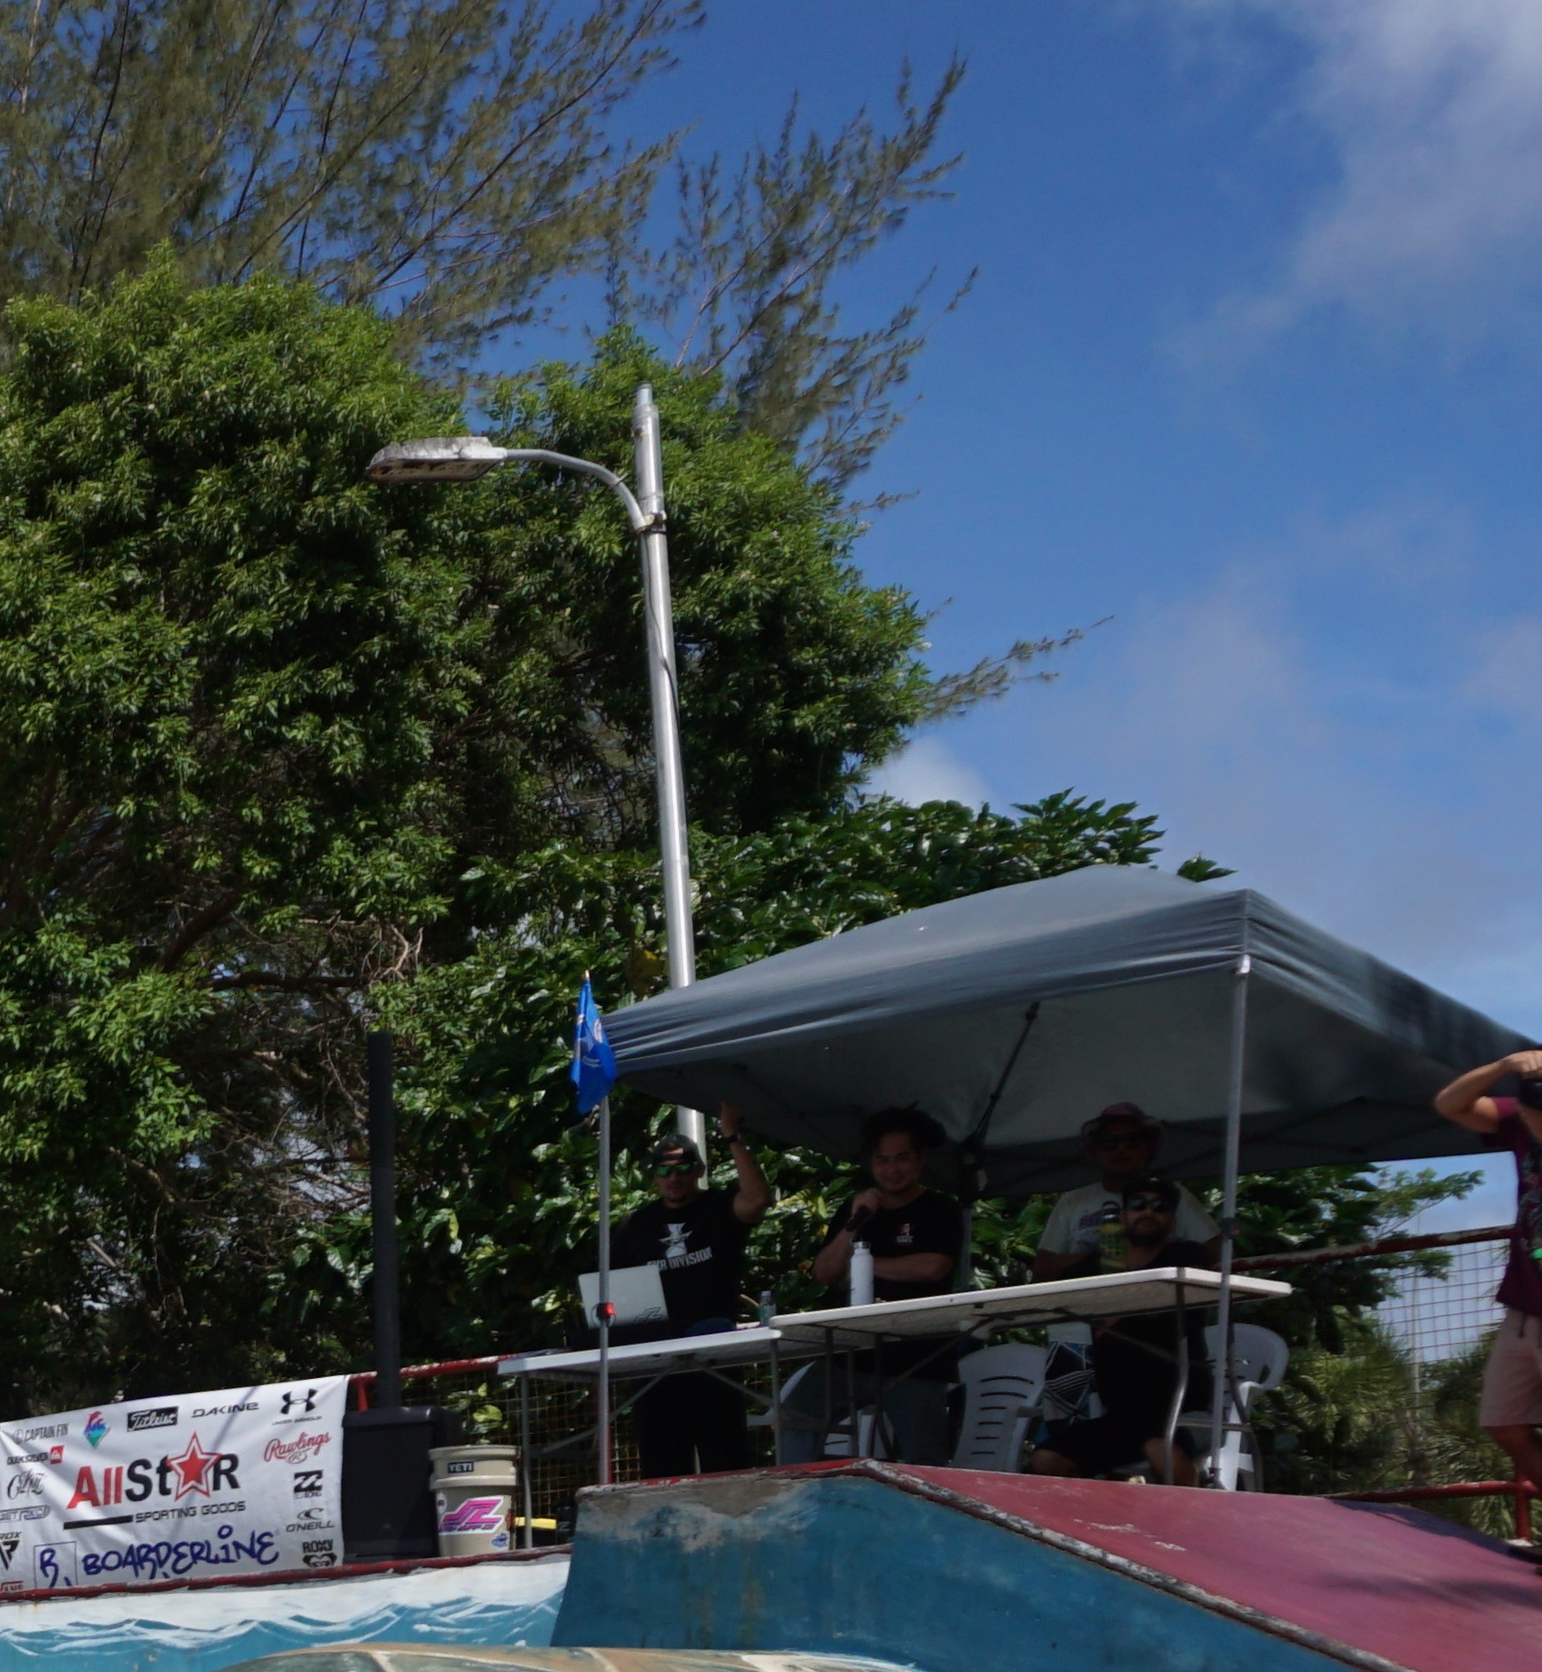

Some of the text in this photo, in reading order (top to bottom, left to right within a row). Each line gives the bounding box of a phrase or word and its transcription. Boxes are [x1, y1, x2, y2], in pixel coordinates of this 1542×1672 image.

[669, 1246, 714, 1270] DIVISION
[191, 1402, 259, 1418] DAKINE
[24, 1426, 55, 1441] CAPTAIN
[264, 1431, 332, 1462] Rawlings
[449, 1462, 473, 1472] YETI
[135, 1500, 246, 1523] SPORTING GOODS
[302, 1539, 334, 1553] ROXY
